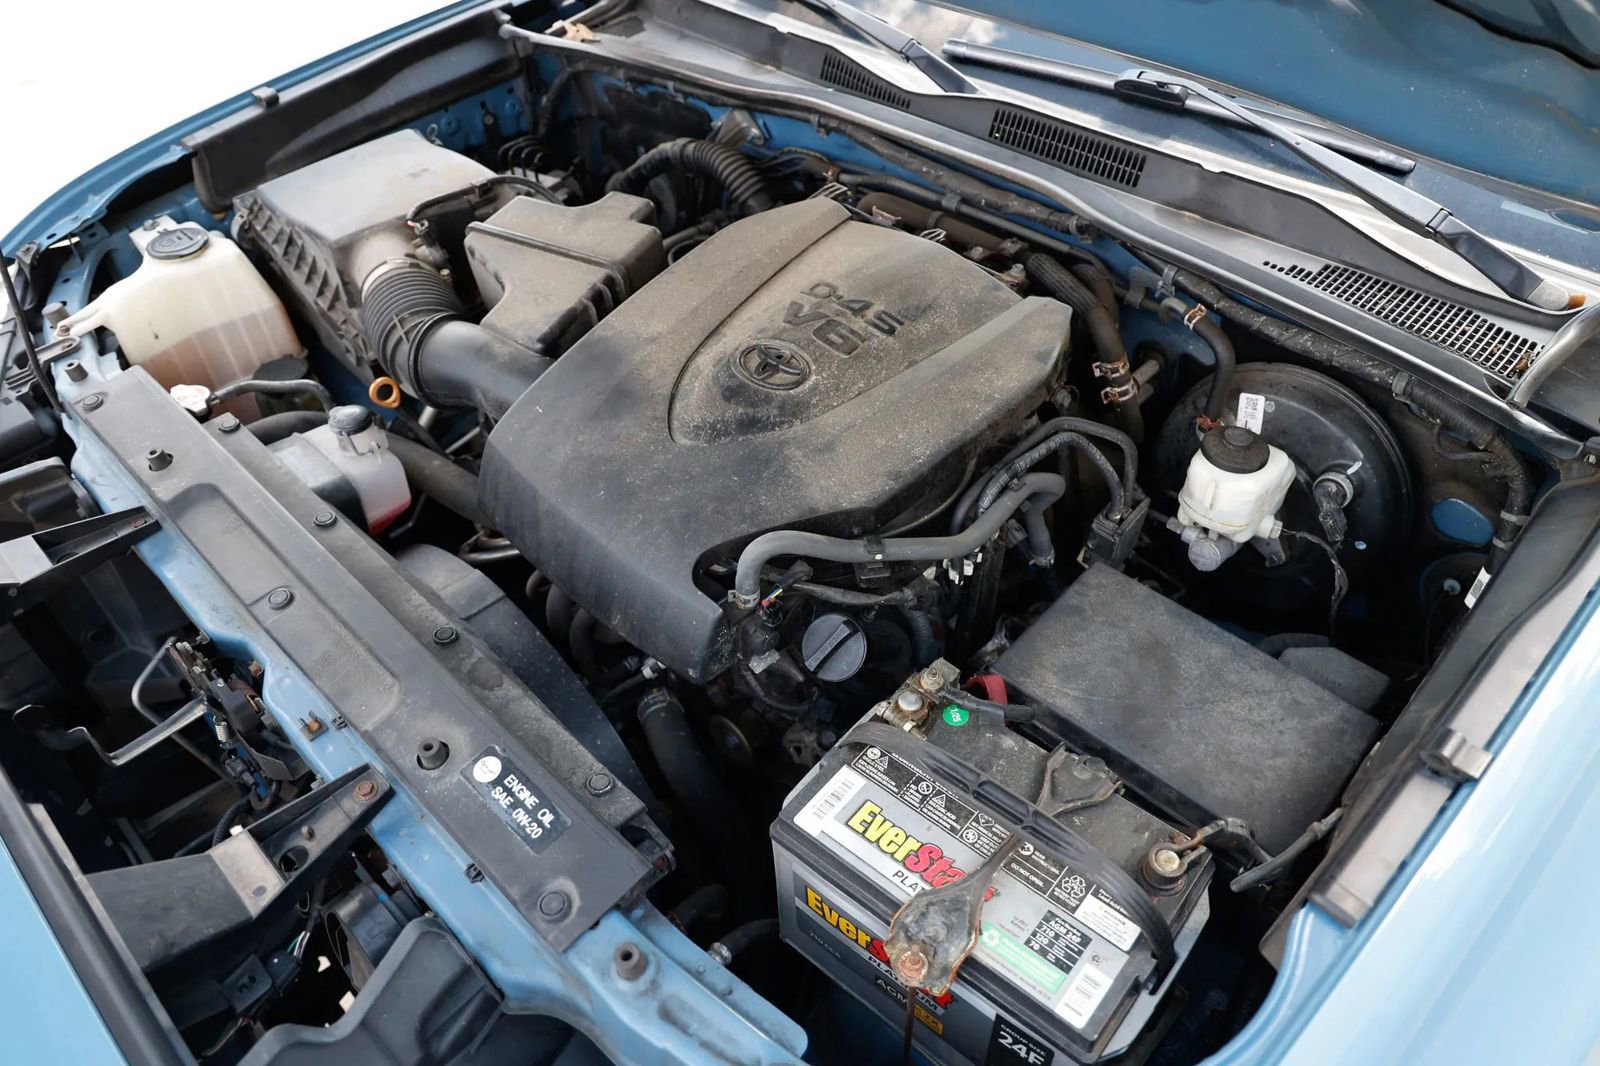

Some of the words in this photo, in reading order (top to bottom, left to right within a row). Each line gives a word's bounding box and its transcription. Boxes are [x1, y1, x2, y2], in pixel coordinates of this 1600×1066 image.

[783, 300, 868, 357] V6
[491, 786, 514, 809] SAE
[512, 807, 543, 839] 0W-20
[503, 773, 540, 810] ENGINE
[537, 808, 555, 828] OIL
[1011, 862, 1020, 871] DO
[1019, 867, 1030, 877] NOT
[1035, 933, 1049, 945] 120
[1040, 924, 1055, 937] 710
[1049, 920, 1068, 934] AGM
[1066, 931, 1082, 943] 24F
[1029, 940, 1040, 950] 70
[876, 979, 909, 1005] AGM
[998, 1031, 1045, 1065] 24F
[1001, 1024, 1029, 1044] GROUP
[1028, 1043, 1046, 1057] SIZE
